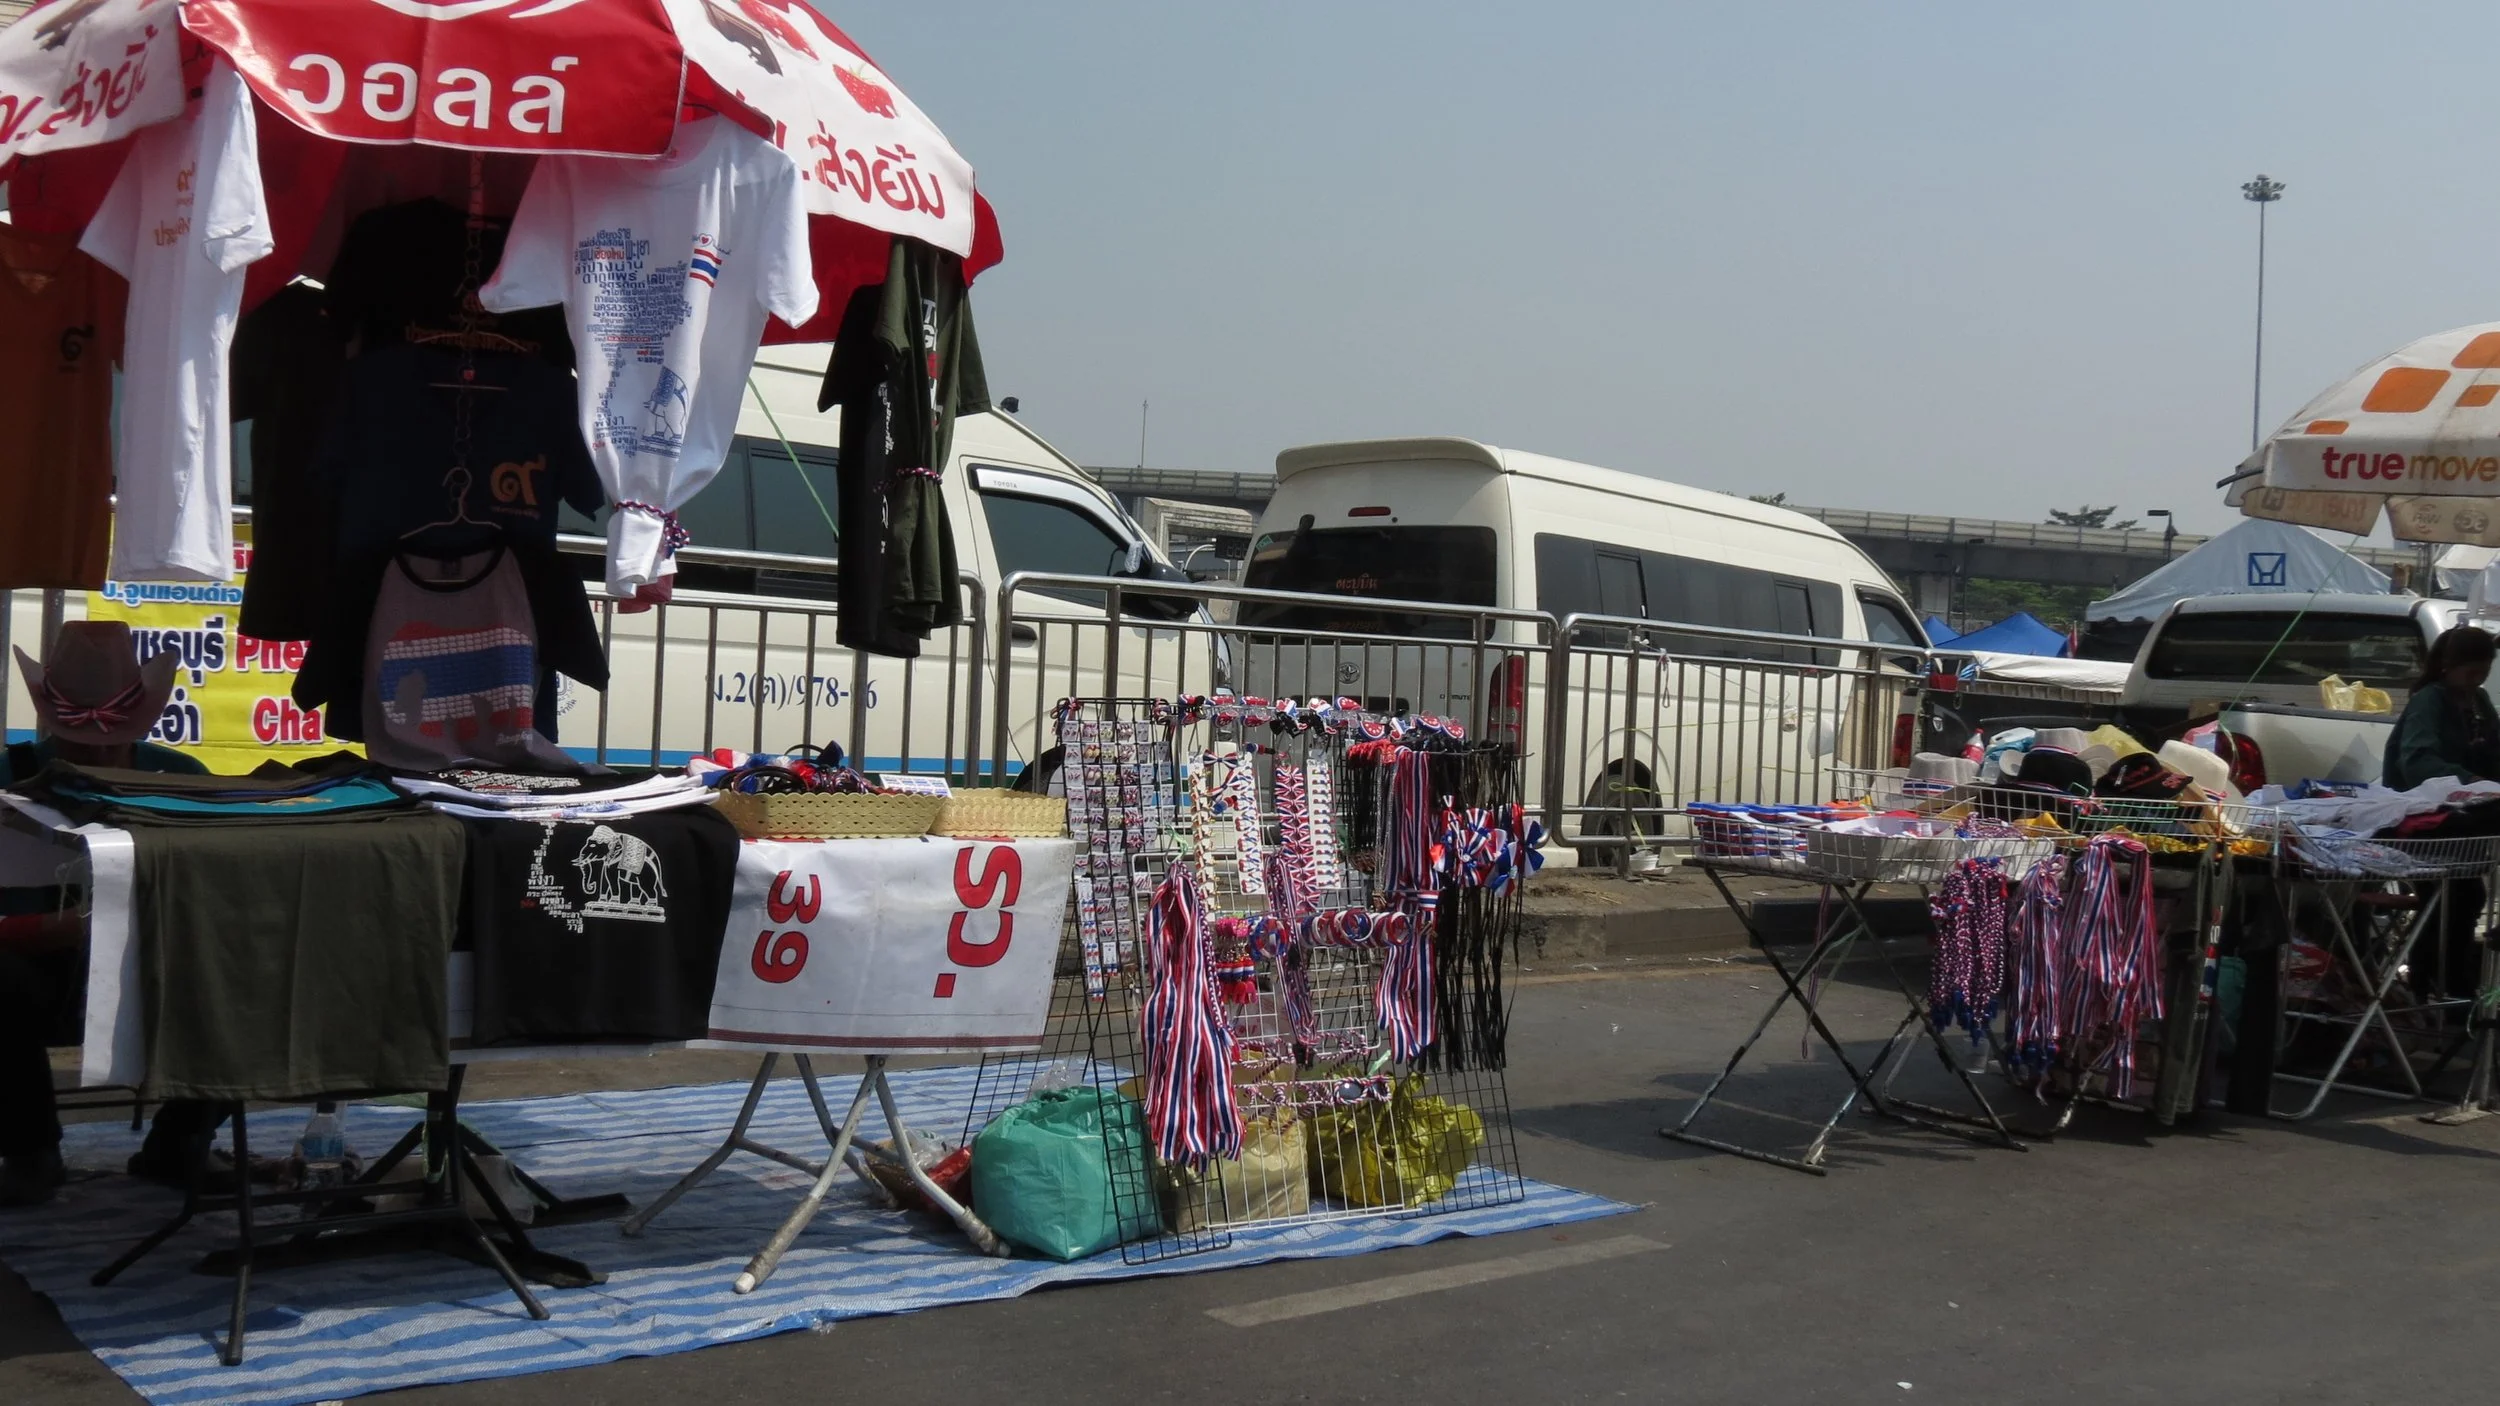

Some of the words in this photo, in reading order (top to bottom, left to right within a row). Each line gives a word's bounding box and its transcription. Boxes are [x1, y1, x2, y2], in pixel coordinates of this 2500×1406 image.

[287, 53, 580, 134] วอลล์
[2322, 446, 2405, 481] true
[2408, 455, 2500, 482] move
[705, 671, 878, 712] .2(ต)/978-6
[253, 697, 321, 741] Cha
[750, 870, 821, 984] 39
